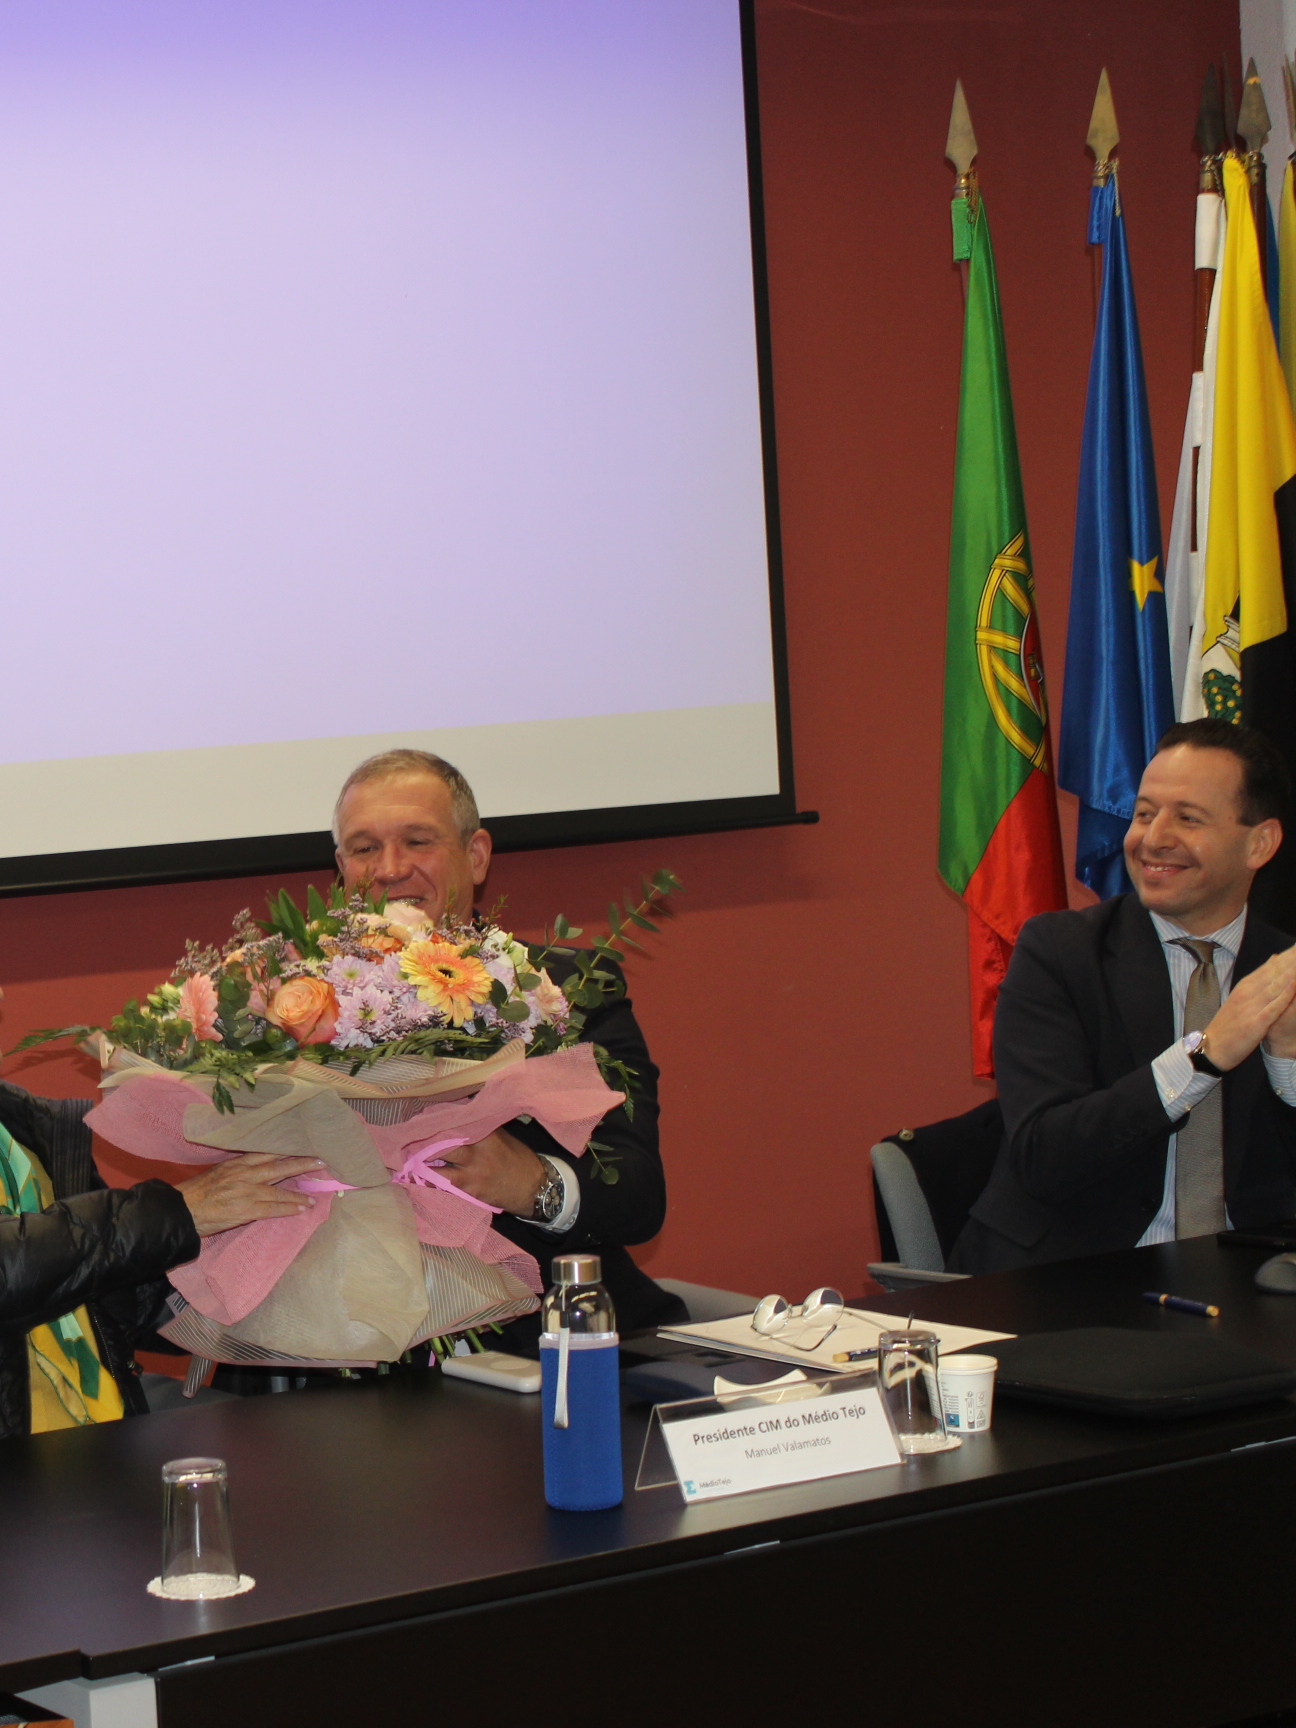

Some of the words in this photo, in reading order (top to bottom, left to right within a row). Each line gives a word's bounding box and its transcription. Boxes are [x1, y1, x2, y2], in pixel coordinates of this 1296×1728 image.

[692, 1425, 757, 1446] Presidente
[758, 1419, 783, 1434] CIM
[784, 1416, 800, 1429] do
[802, 1408, 840, 1426] Médio
[840, 1404, 867, 1420] Tejo
[744, 1443, 782, 1460] Manuel
[783, 1435, 832, 1453] Valamatos
